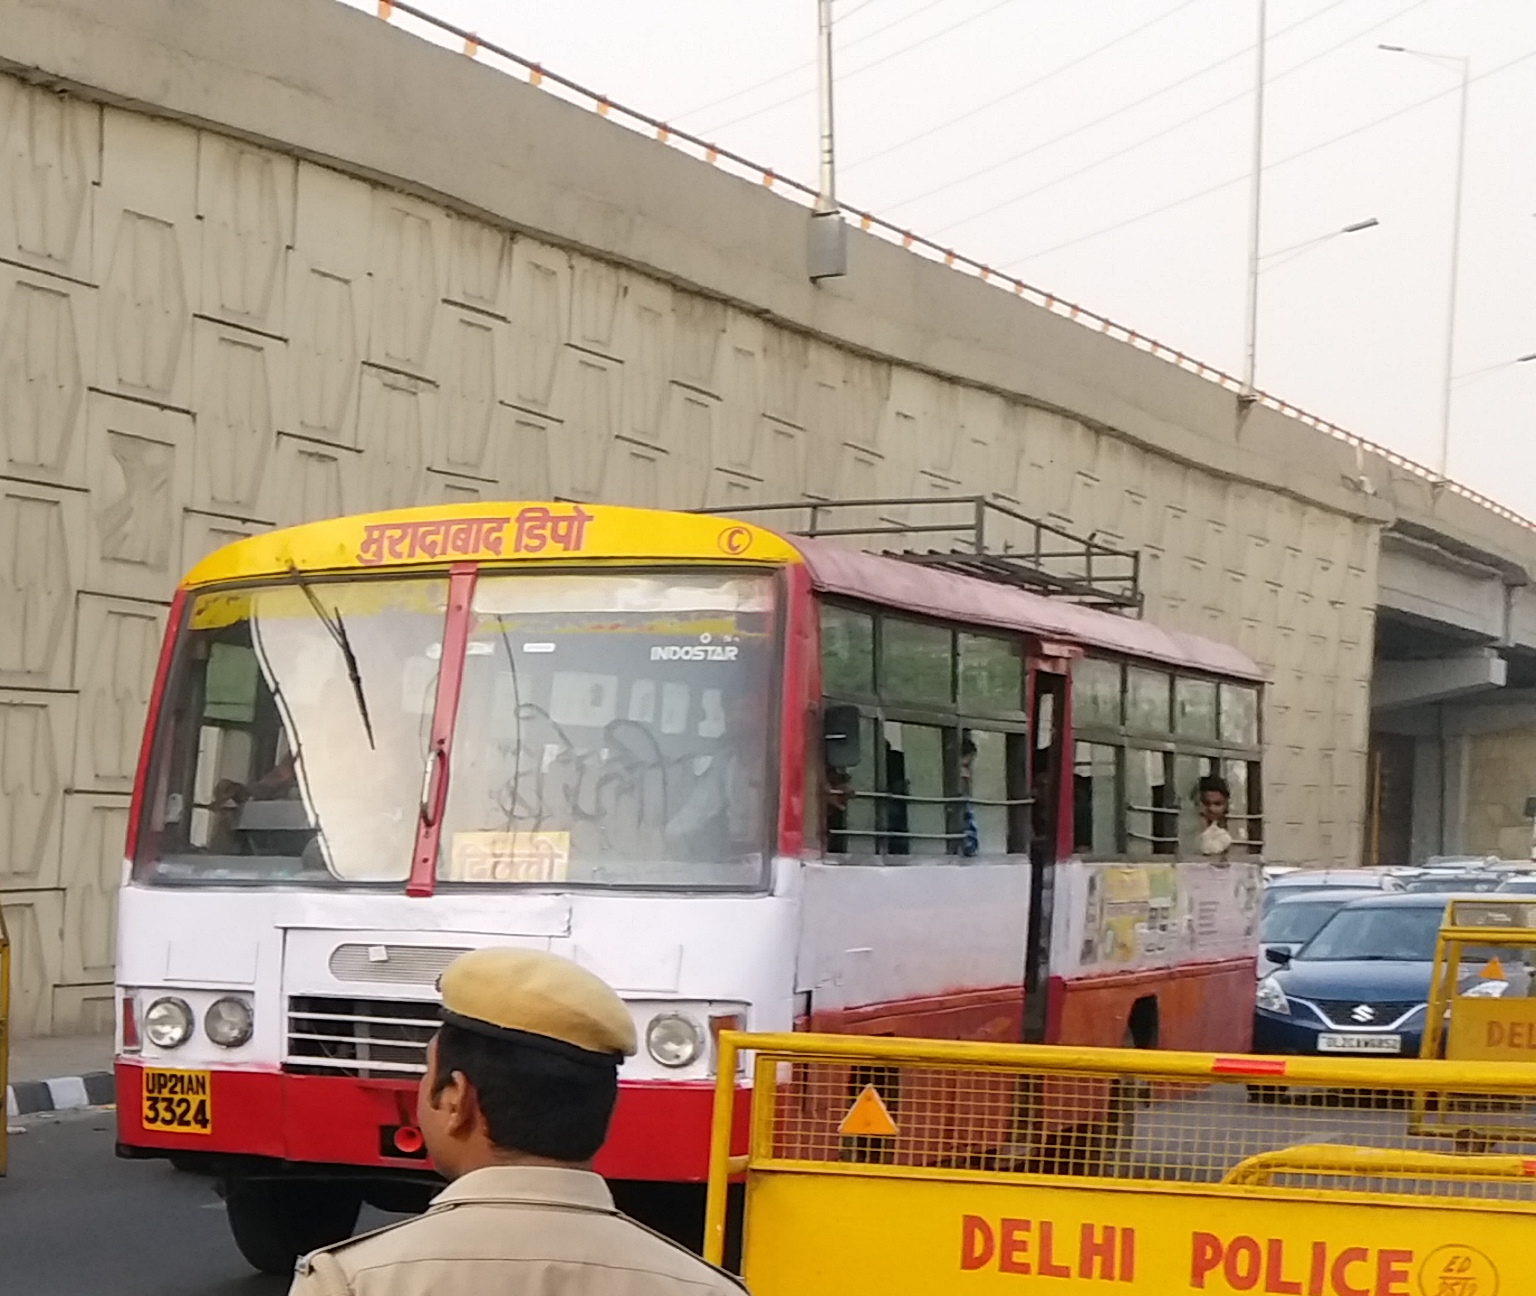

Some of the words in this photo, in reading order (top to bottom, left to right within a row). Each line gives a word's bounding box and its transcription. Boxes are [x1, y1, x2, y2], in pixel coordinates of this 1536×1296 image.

[356, 516, 510, 565] मुरादाबाद
[513, 505, 595, 554] डिपो
[650, 646, 738, 662] INDOSTAR
[145, 1073, 206, 1095] UP21AN
[144, 1096, 210, 1129] 3324
[960, 1214, 1136, 1283] DELHI
